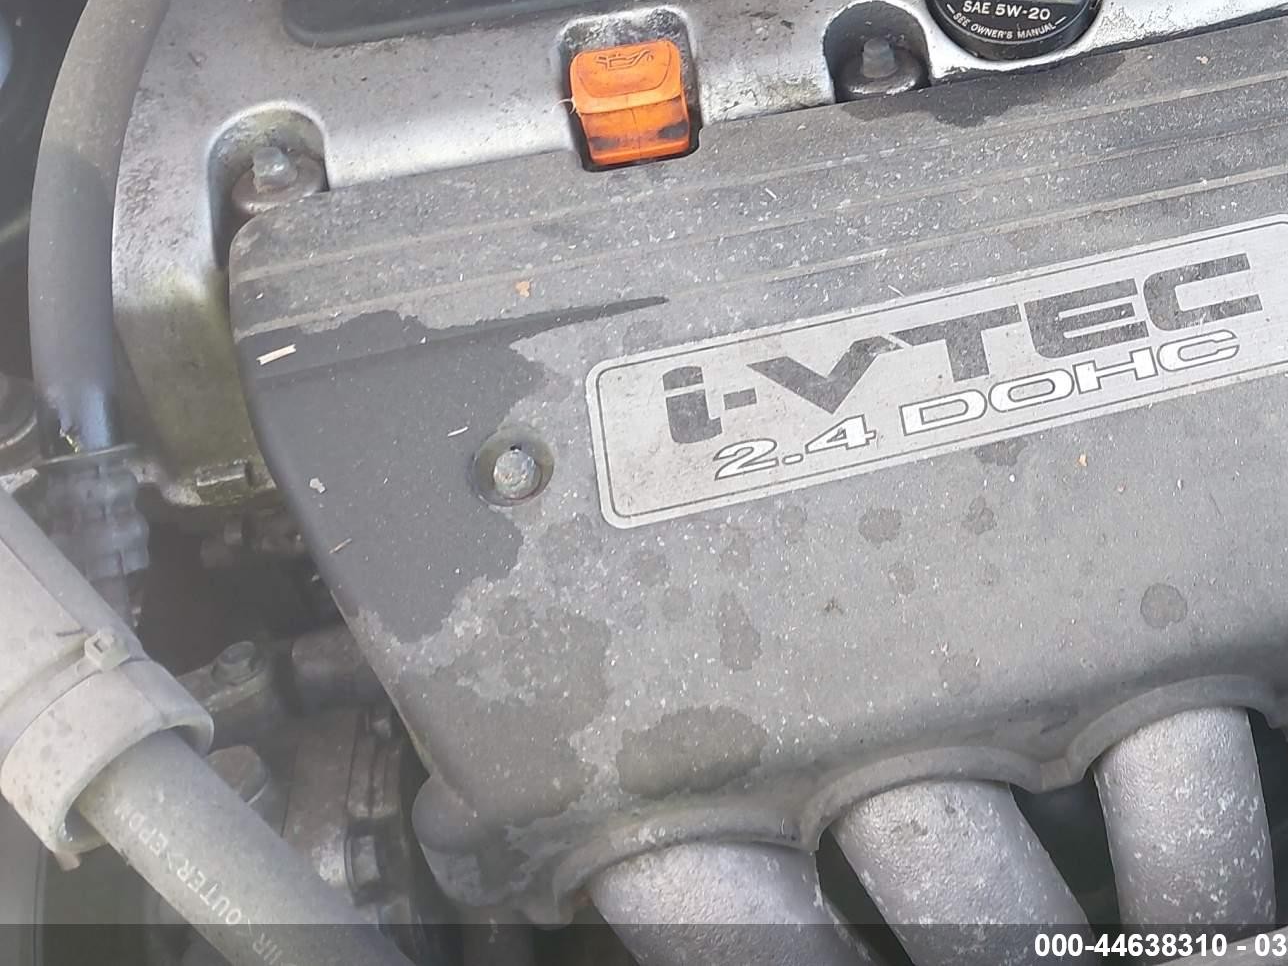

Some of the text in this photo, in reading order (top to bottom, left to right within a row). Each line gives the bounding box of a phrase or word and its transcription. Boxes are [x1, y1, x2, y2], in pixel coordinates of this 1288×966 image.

[953, 12, 1057, 40] SEE OWNER'S MANUAL
[963, 0, 1051, 21] SAE 5W-20
[662, 253, 1263, 445] i-VTEC
[714, 329, 1241, 480] 2.4 DOHC
